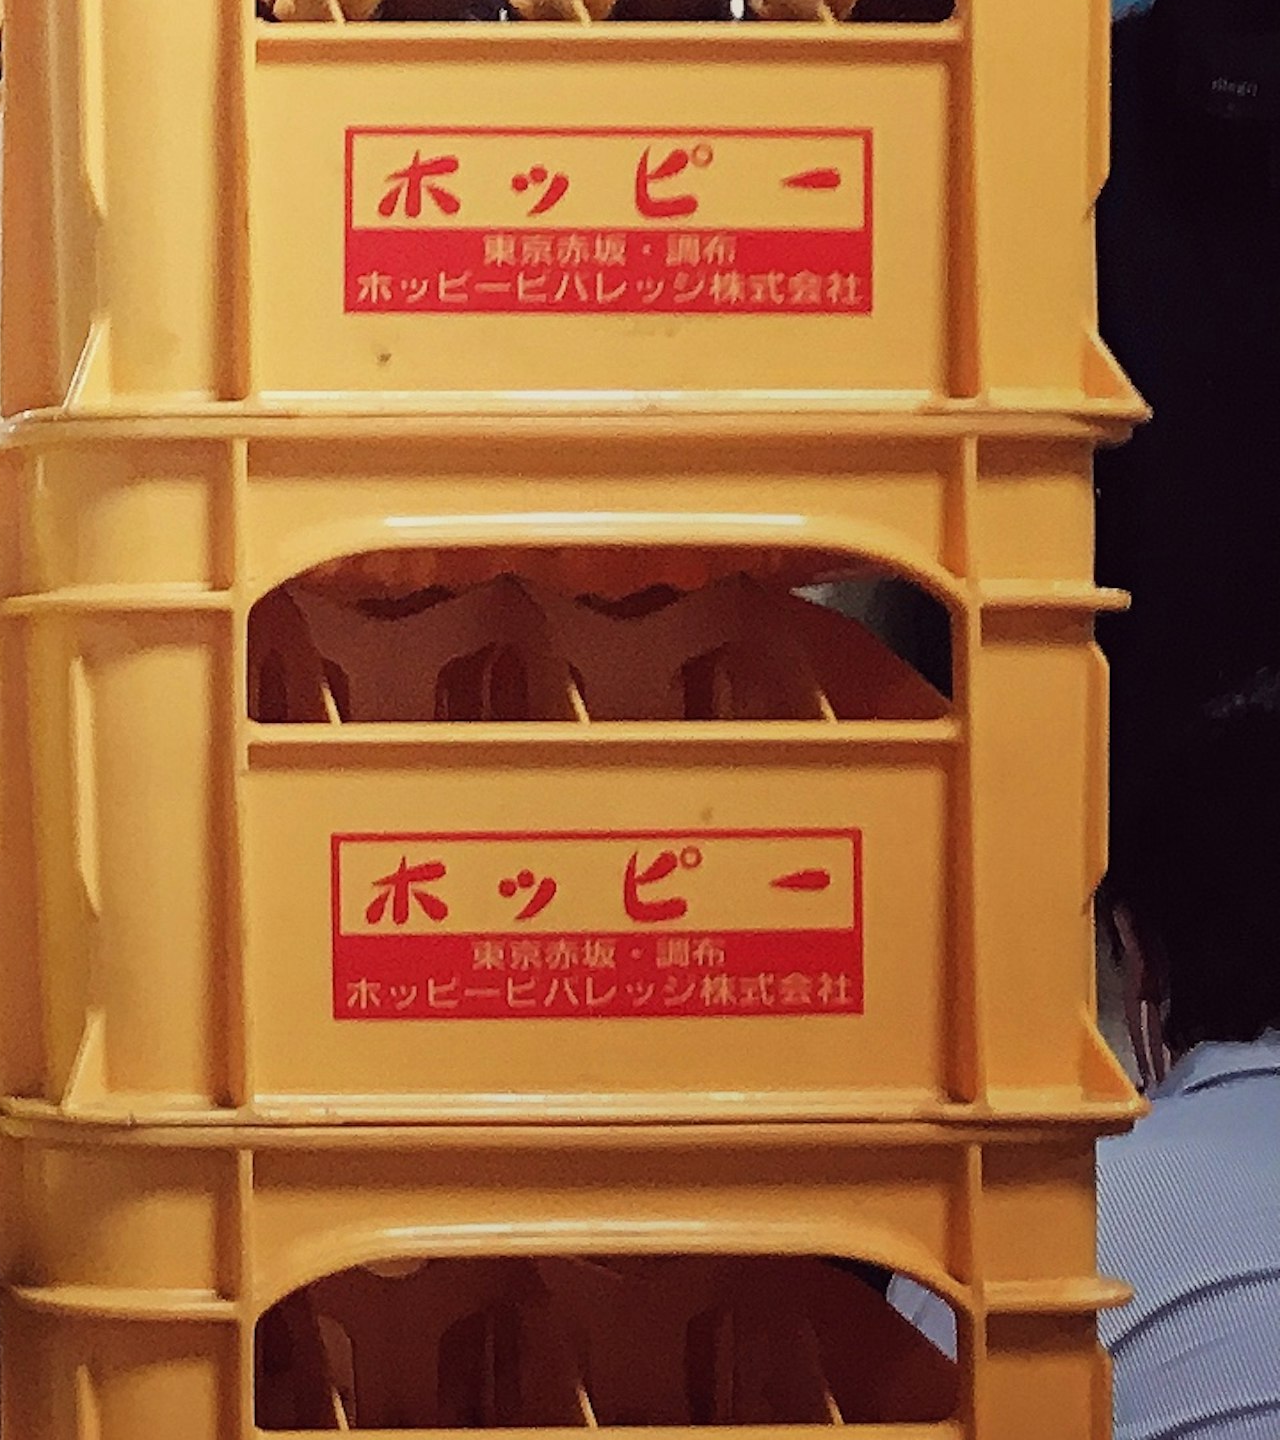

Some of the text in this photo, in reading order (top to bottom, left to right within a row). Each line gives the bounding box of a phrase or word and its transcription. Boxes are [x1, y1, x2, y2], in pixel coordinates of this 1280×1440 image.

[377, 143, 842, 219] ホッピー
[482, 234, 737, 268] 東京赤坂・調布
[365, 845, 831, 924] ホッピー
[472, 938, 726, 972] 東京赤坂・調布
[345, 972, 854, 1010] ホッピービバレッジ株式会社
